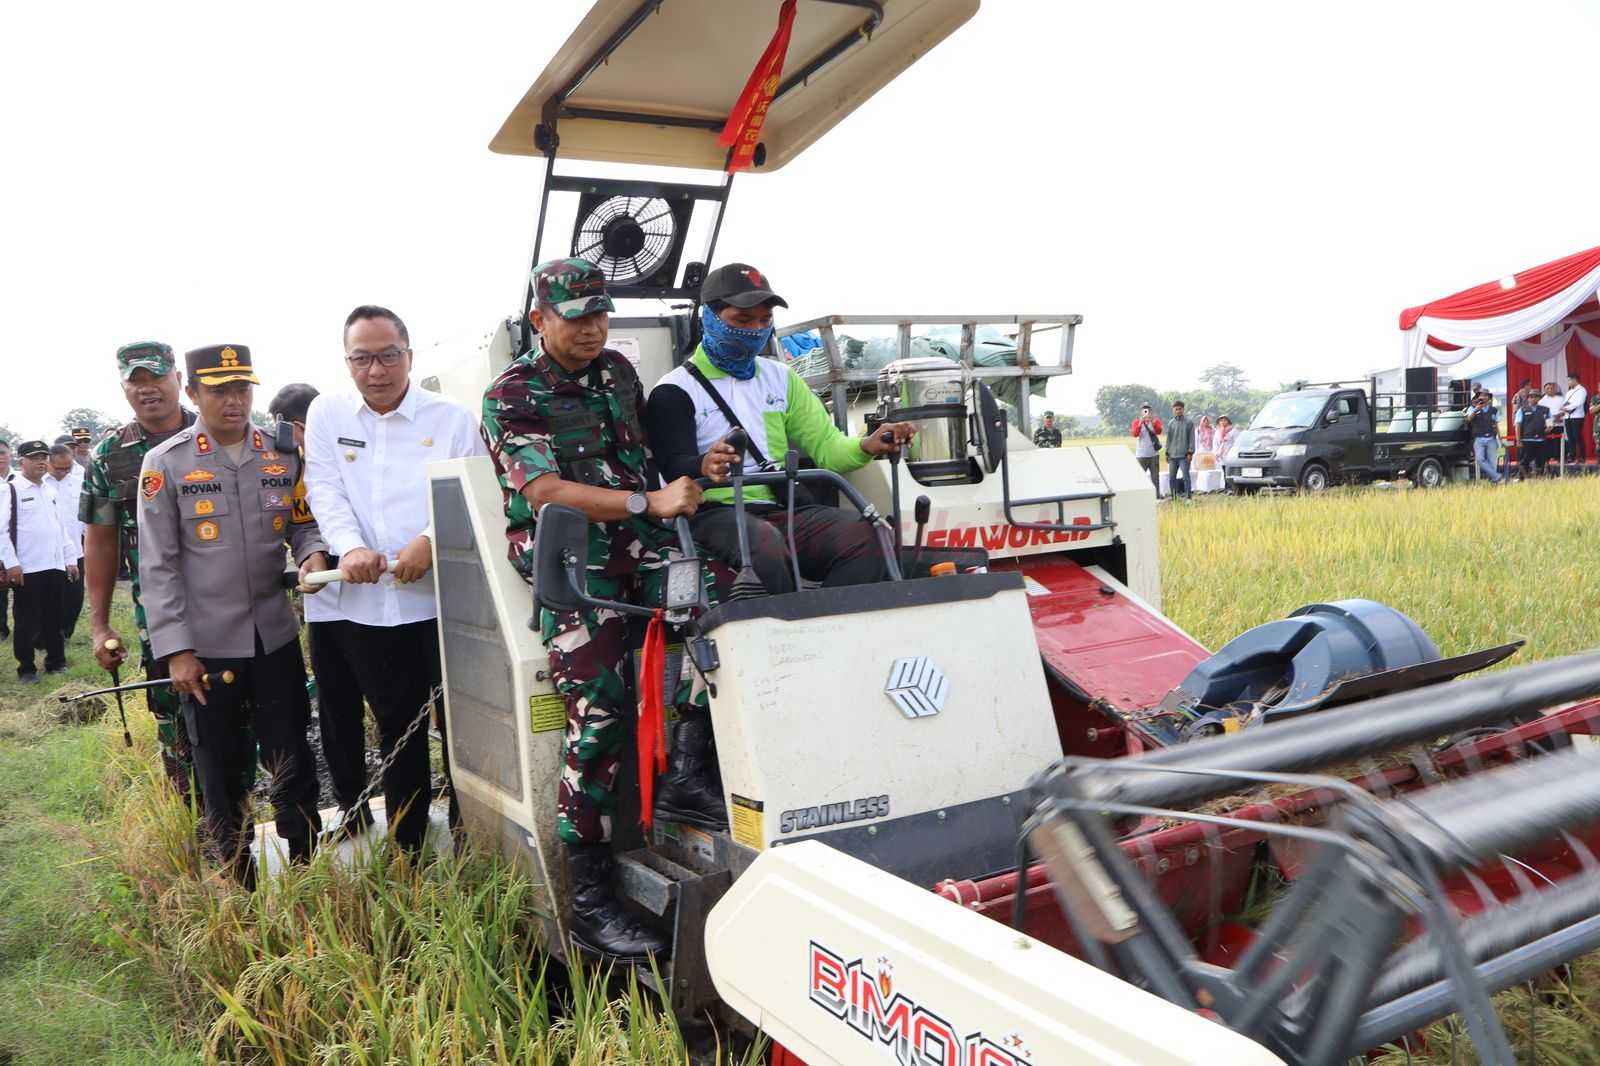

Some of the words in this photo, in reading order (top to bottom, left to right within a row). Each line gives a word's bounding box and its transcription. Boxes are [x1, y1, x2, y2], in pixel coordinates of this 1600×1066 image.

[181, 482, 223, 495] ROVAN
[261, 477, 292, 488] POLRI
[780, 794, 889, 834] STAINLESS
